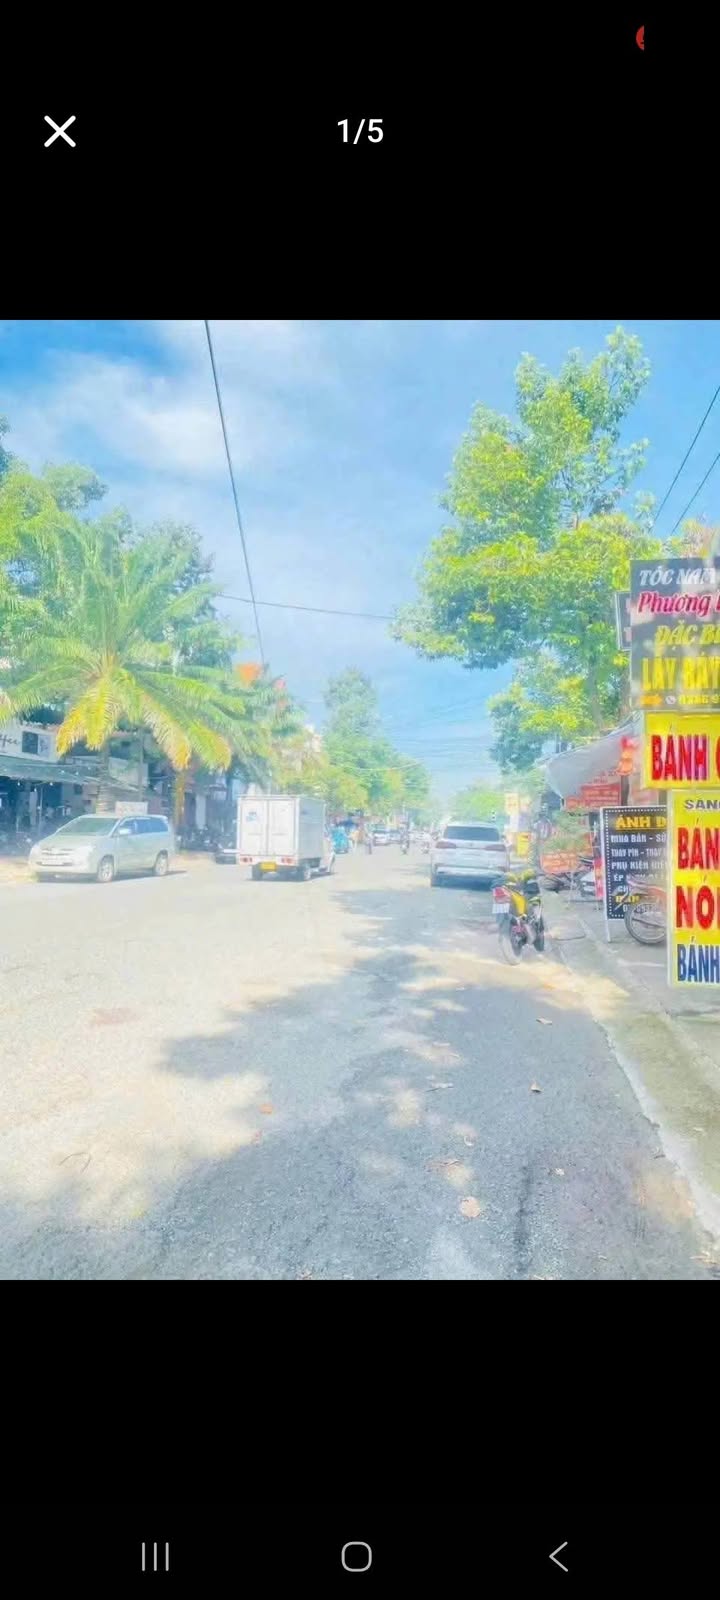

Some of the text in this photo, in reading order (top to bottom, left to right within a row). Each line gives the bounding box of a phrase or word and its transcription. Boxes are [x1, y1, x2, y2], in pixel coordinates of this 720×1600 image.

[638, 591, 712, 618] Phương
[651, 722, 708, 781] BÁNH
[684, 793, 720, 810] SÁN
[676, 936, 720, 983] BÁNH
